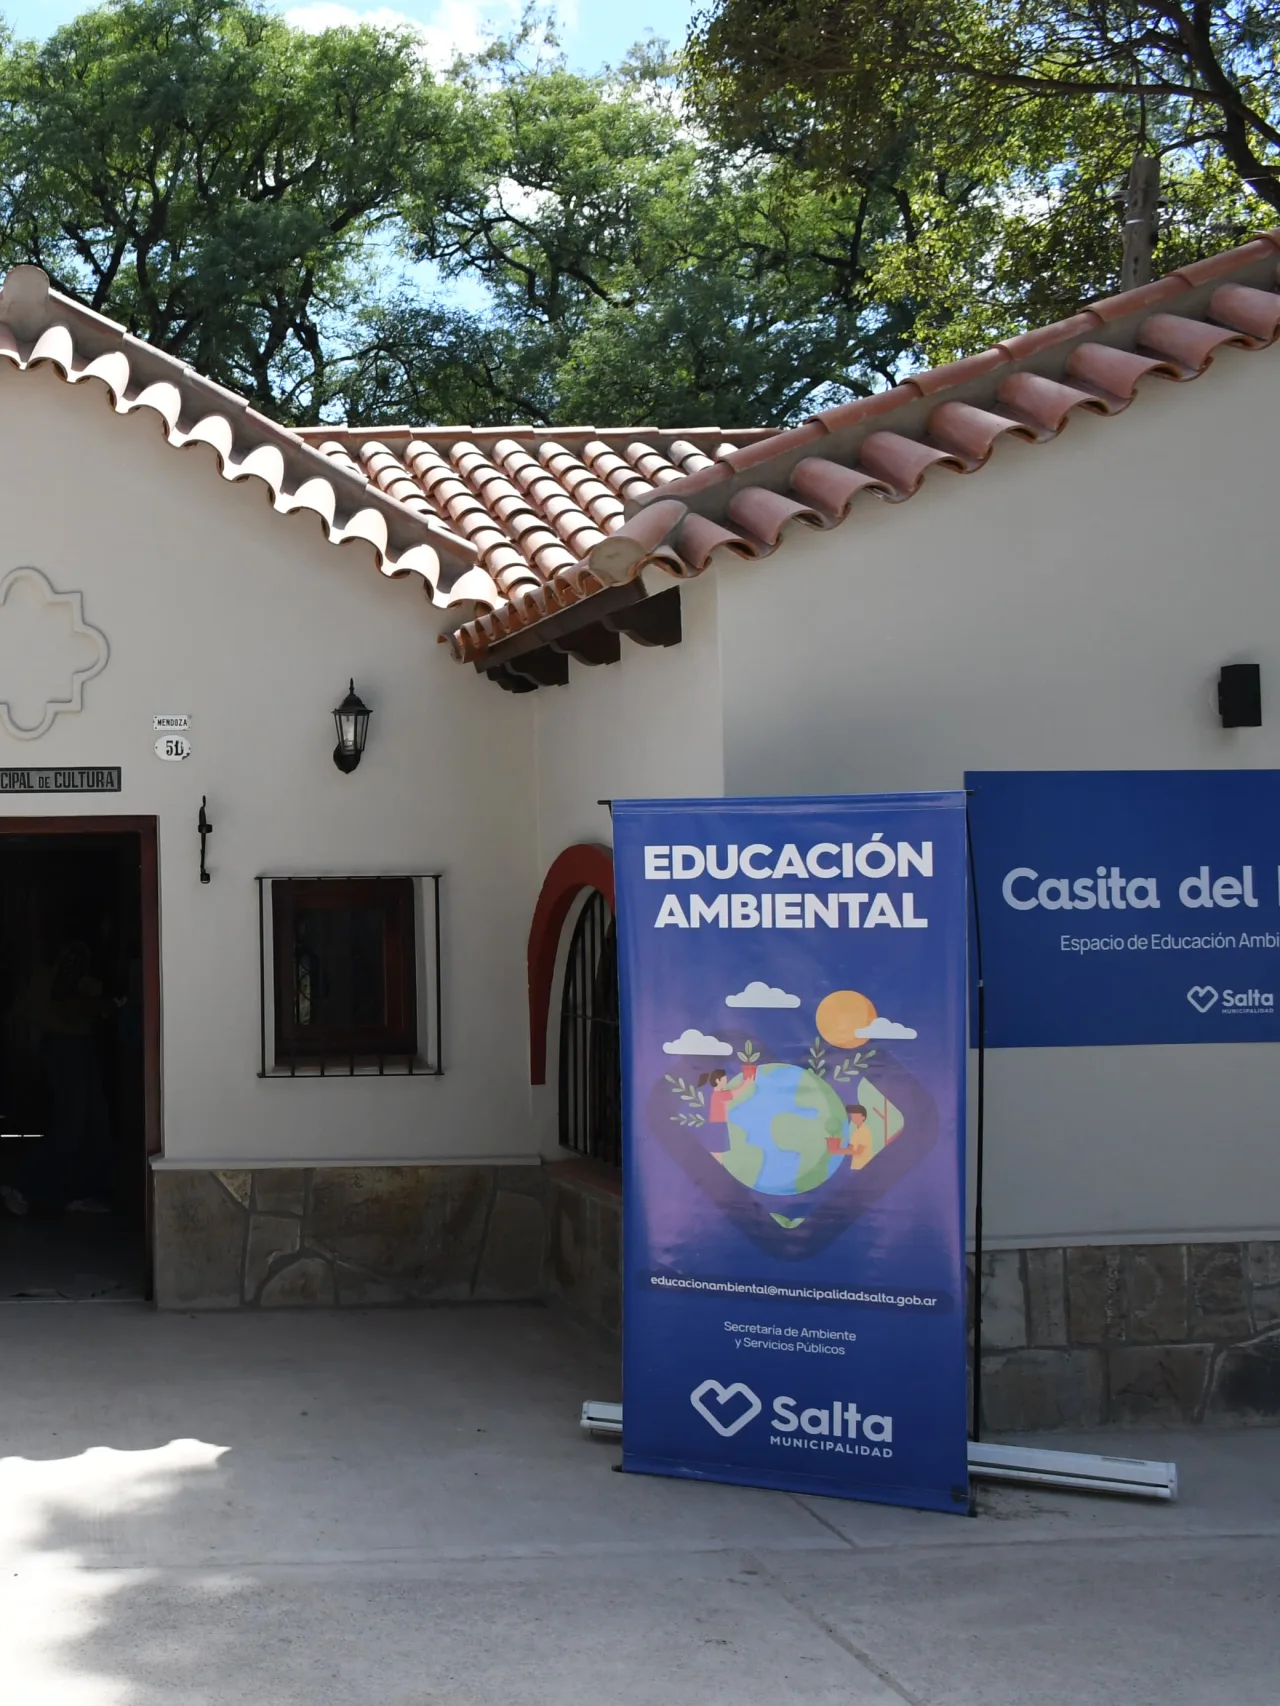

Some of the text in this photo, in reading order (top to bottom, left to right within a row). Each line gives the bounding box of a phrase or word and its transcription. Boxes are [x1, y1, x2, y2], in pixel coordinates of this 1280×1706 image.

[157, 718, 188, 727] MENDOZA
[54, 771, 114, 789] CULTURA
[644, 833, 933, 880] EDUCACIÓN
[1002, 866, 1161, 910] Casita
[1178, 865, 1259, 908] del
[654, 892, 928, 928] AMBIENTAL
[1060, 934, 1124, 955] Espacio
[1127, 934, 1148, 950] de
[1151, 931, 1236, 950] Educación
[1222, 989, 1274, 1006] Salta
[650, 1275, 937, 1307] educacionambiental@municipalidadsalta.gob.ar
[783, 1327, 799, 1337] de
[800, 1328, 857, 1341] Ambiente
[735, 1337, 846, 1355] y Servicios Públicos
[771, 1395, 893, 1443] Salta
[770, 1435, 893, 1458] MUNICIPALIDAD
